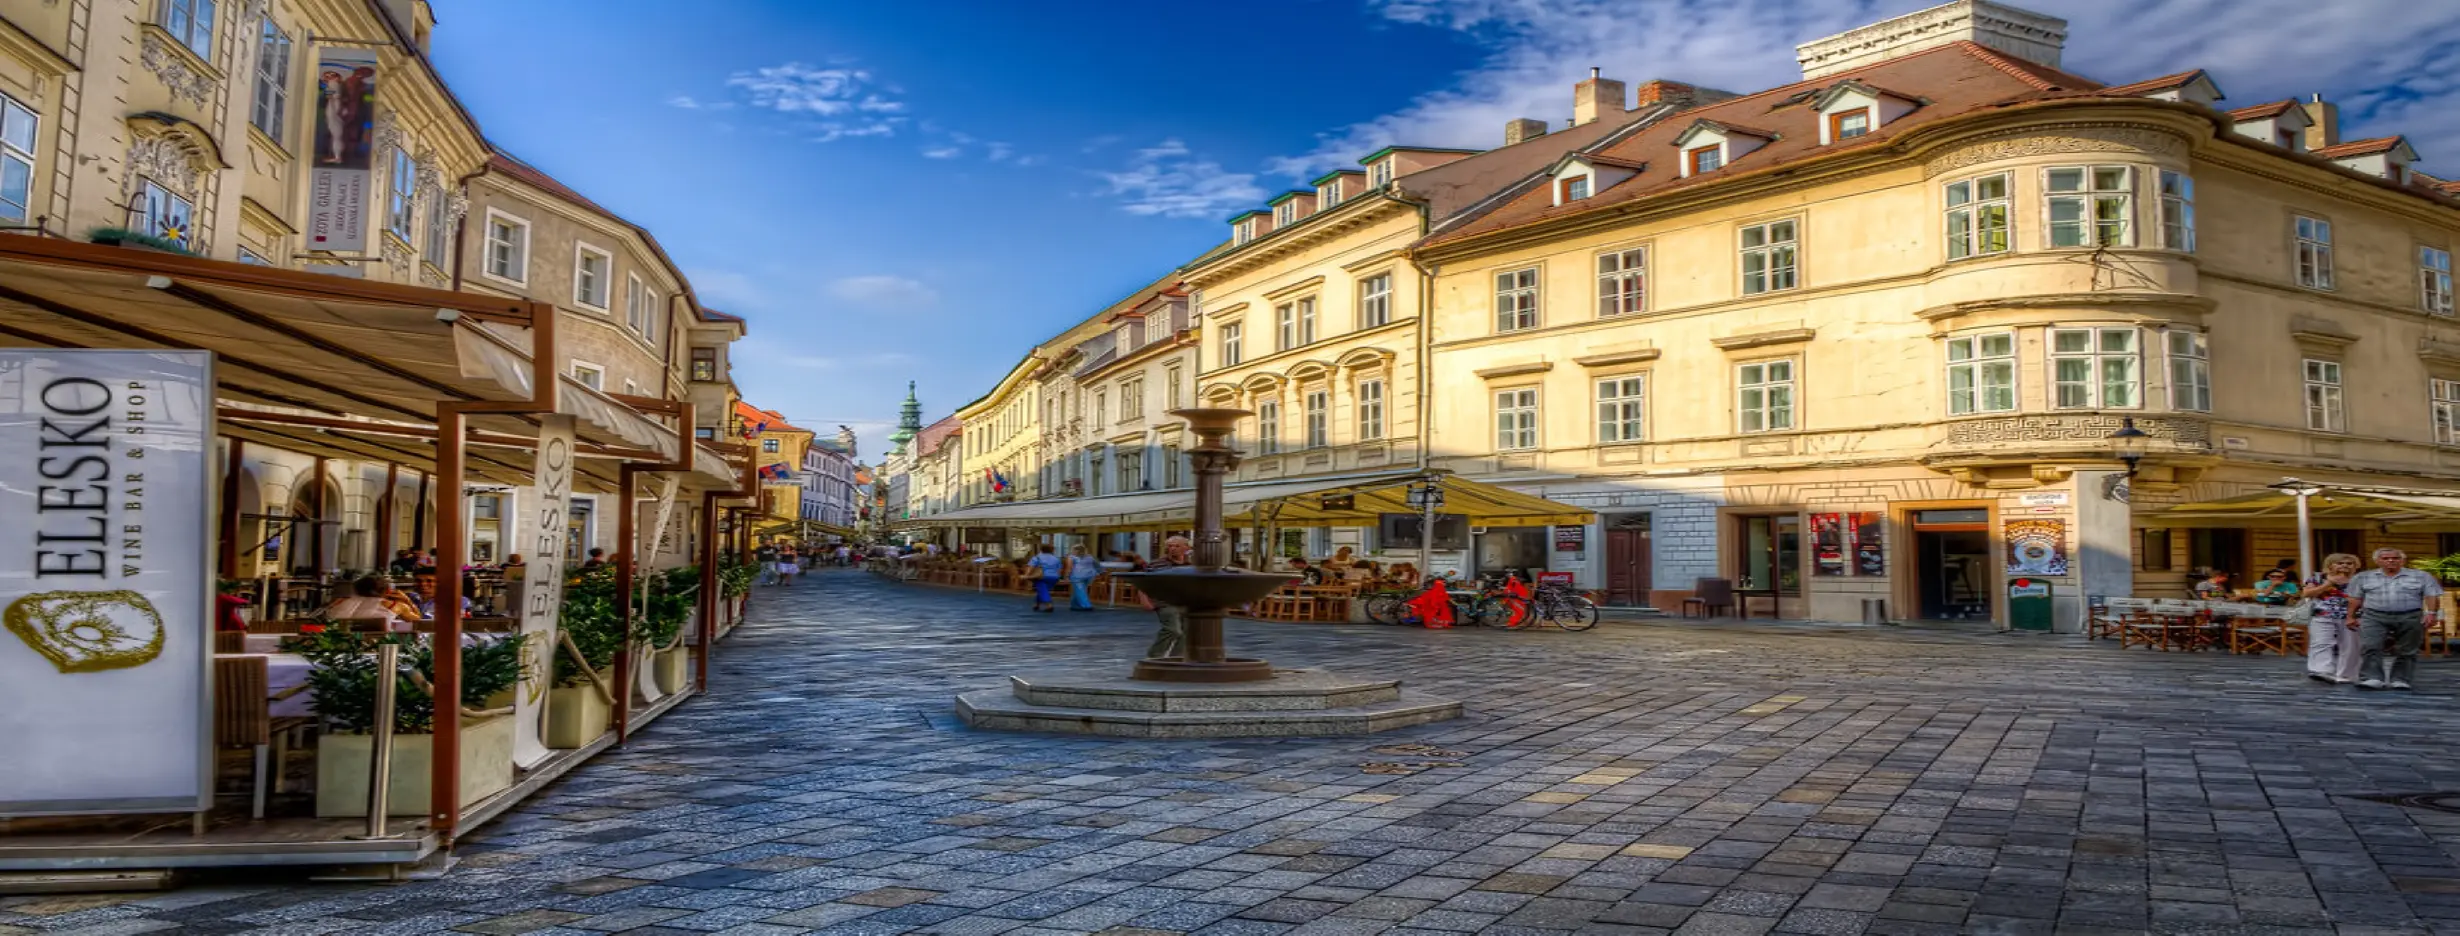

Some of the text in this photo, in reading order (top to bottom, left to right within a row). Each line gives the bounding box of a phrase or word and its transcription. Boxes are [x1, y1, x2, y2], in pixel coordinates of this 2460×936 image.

[314, 171, 332, 234] ZOYA GALLERY
[34, 376, 112, 580] ELESKO
[122, 380, 146, 578] WINE BAR & SHOP
[530, 437, 566, 617] ELESKO
